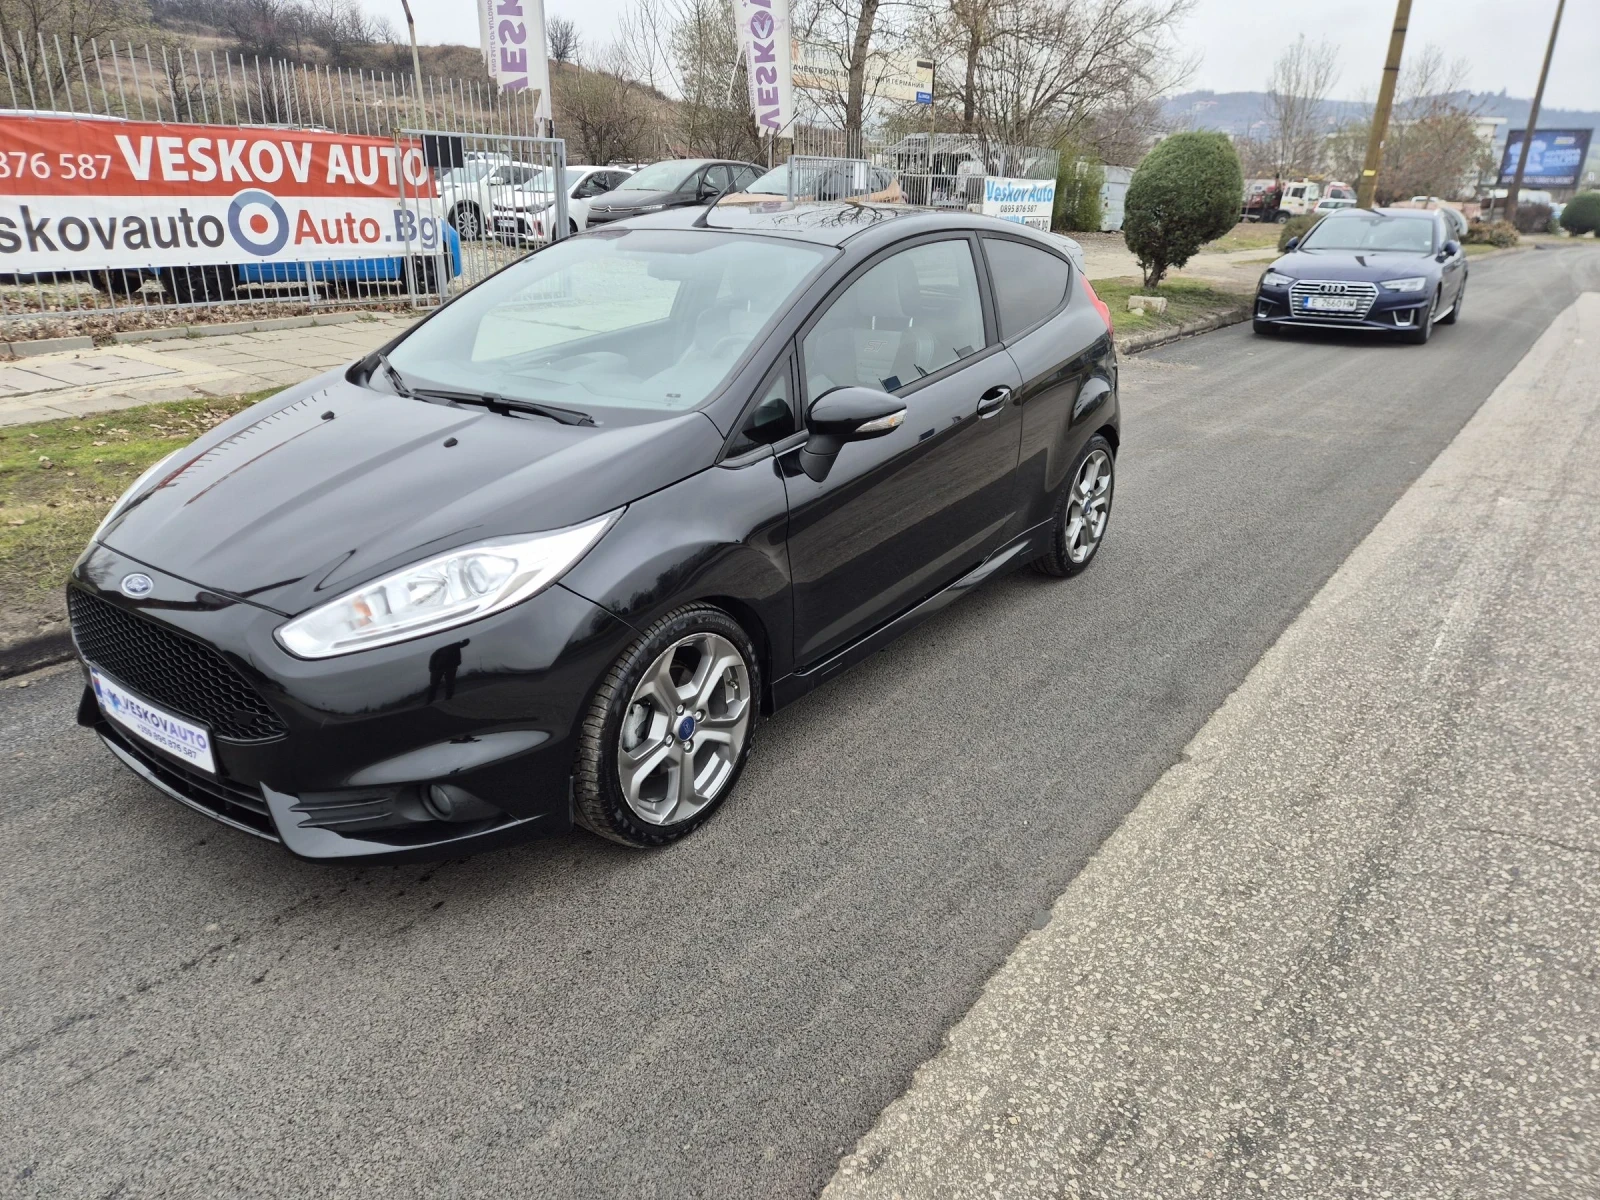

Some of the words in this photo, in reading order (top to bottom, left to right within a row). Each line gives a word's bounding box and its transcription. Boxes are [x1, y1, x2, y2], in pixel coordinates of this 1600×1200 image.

[59, 153, 112, 180] 587
[114, 134, 312, 183] VESKOV
[326, 143, 429, 187] AUTO
[986, 180, 1030, 202] Veskov
[1028, 184, 1053, 202] Auto
[1000, 204, 1015, 213] 0895
[1015, 204, 1026, 213] 876
[1027, 204, 1038, 213] 587
[294, 209, 439, 250] Auto.Bg
[168, 740, 182, 753] 876
[183, 747, 197, 759] 587
